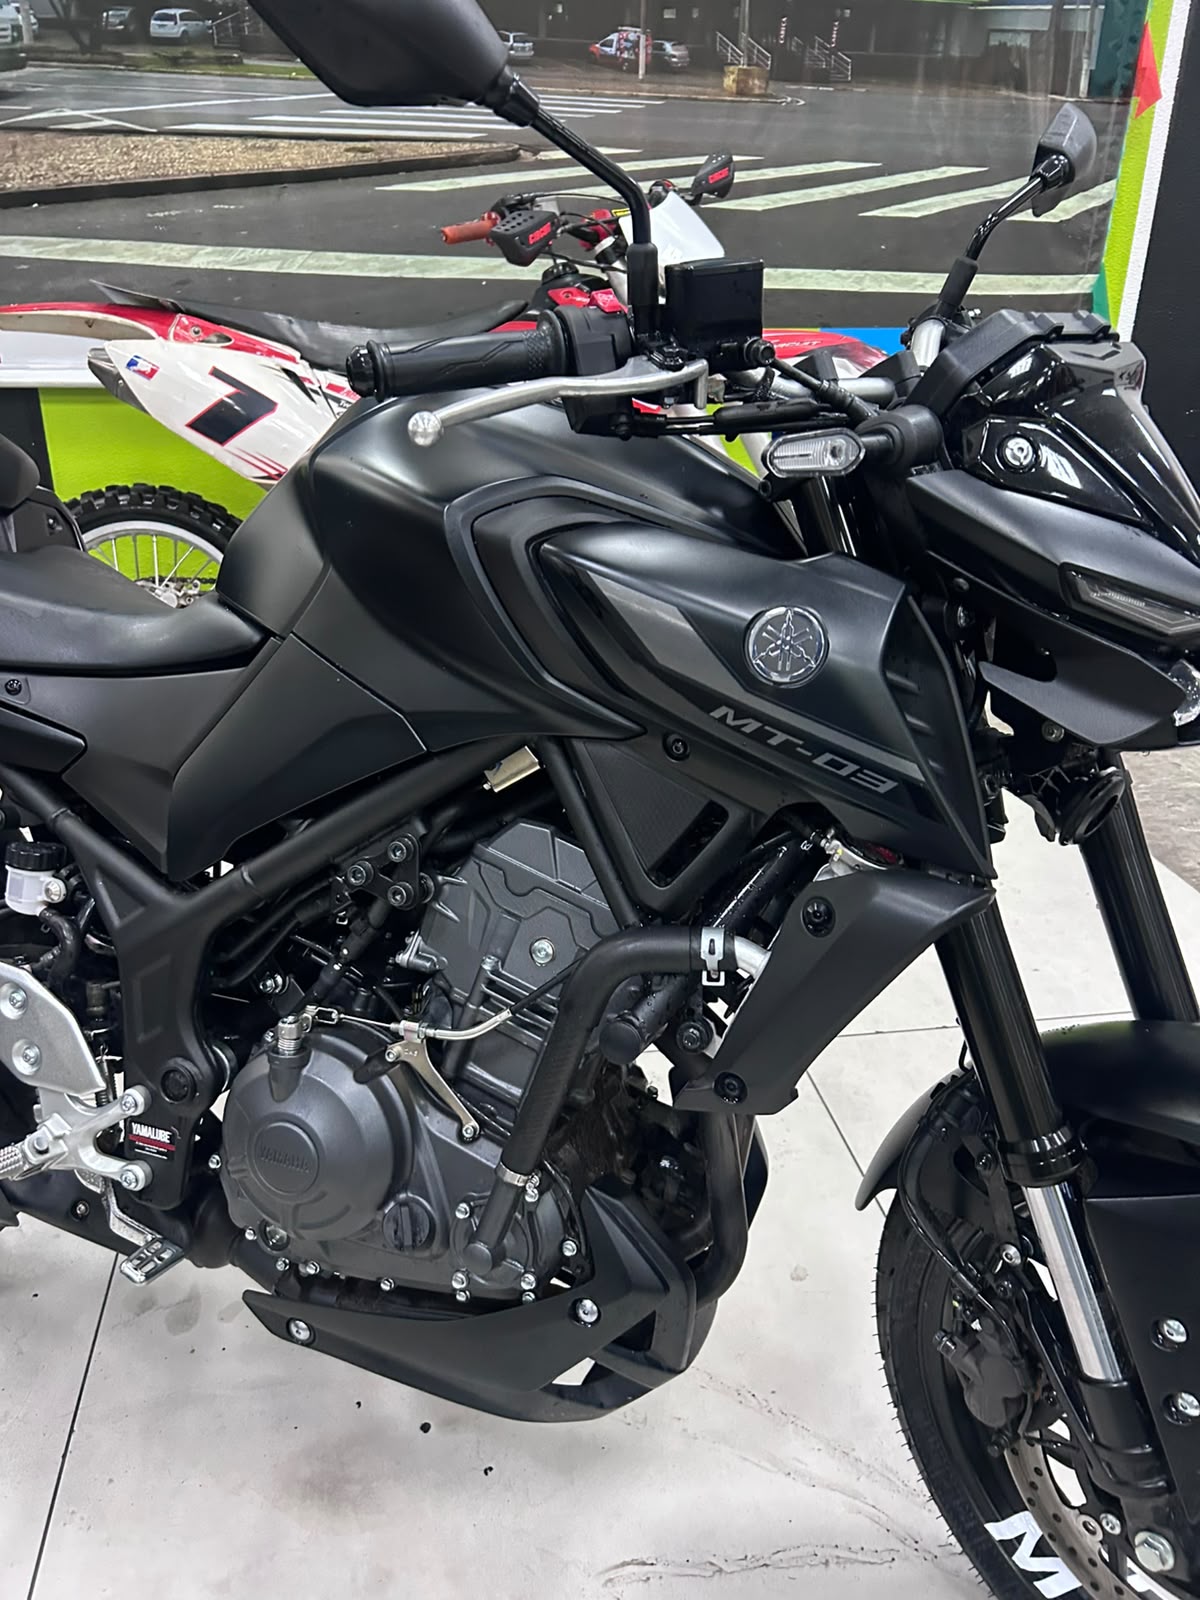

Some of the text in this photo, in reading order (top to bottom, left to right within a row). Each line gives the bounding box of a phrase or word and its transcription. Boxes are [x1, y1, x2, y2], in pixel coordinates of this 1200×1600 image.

[185, 365, 279, 447] 7
[709, 705, 899, 794] MT-03
[131, 1121, 173, 1144] YAMALUBE
[258, 1145, 311, 1174] YAMAHA
